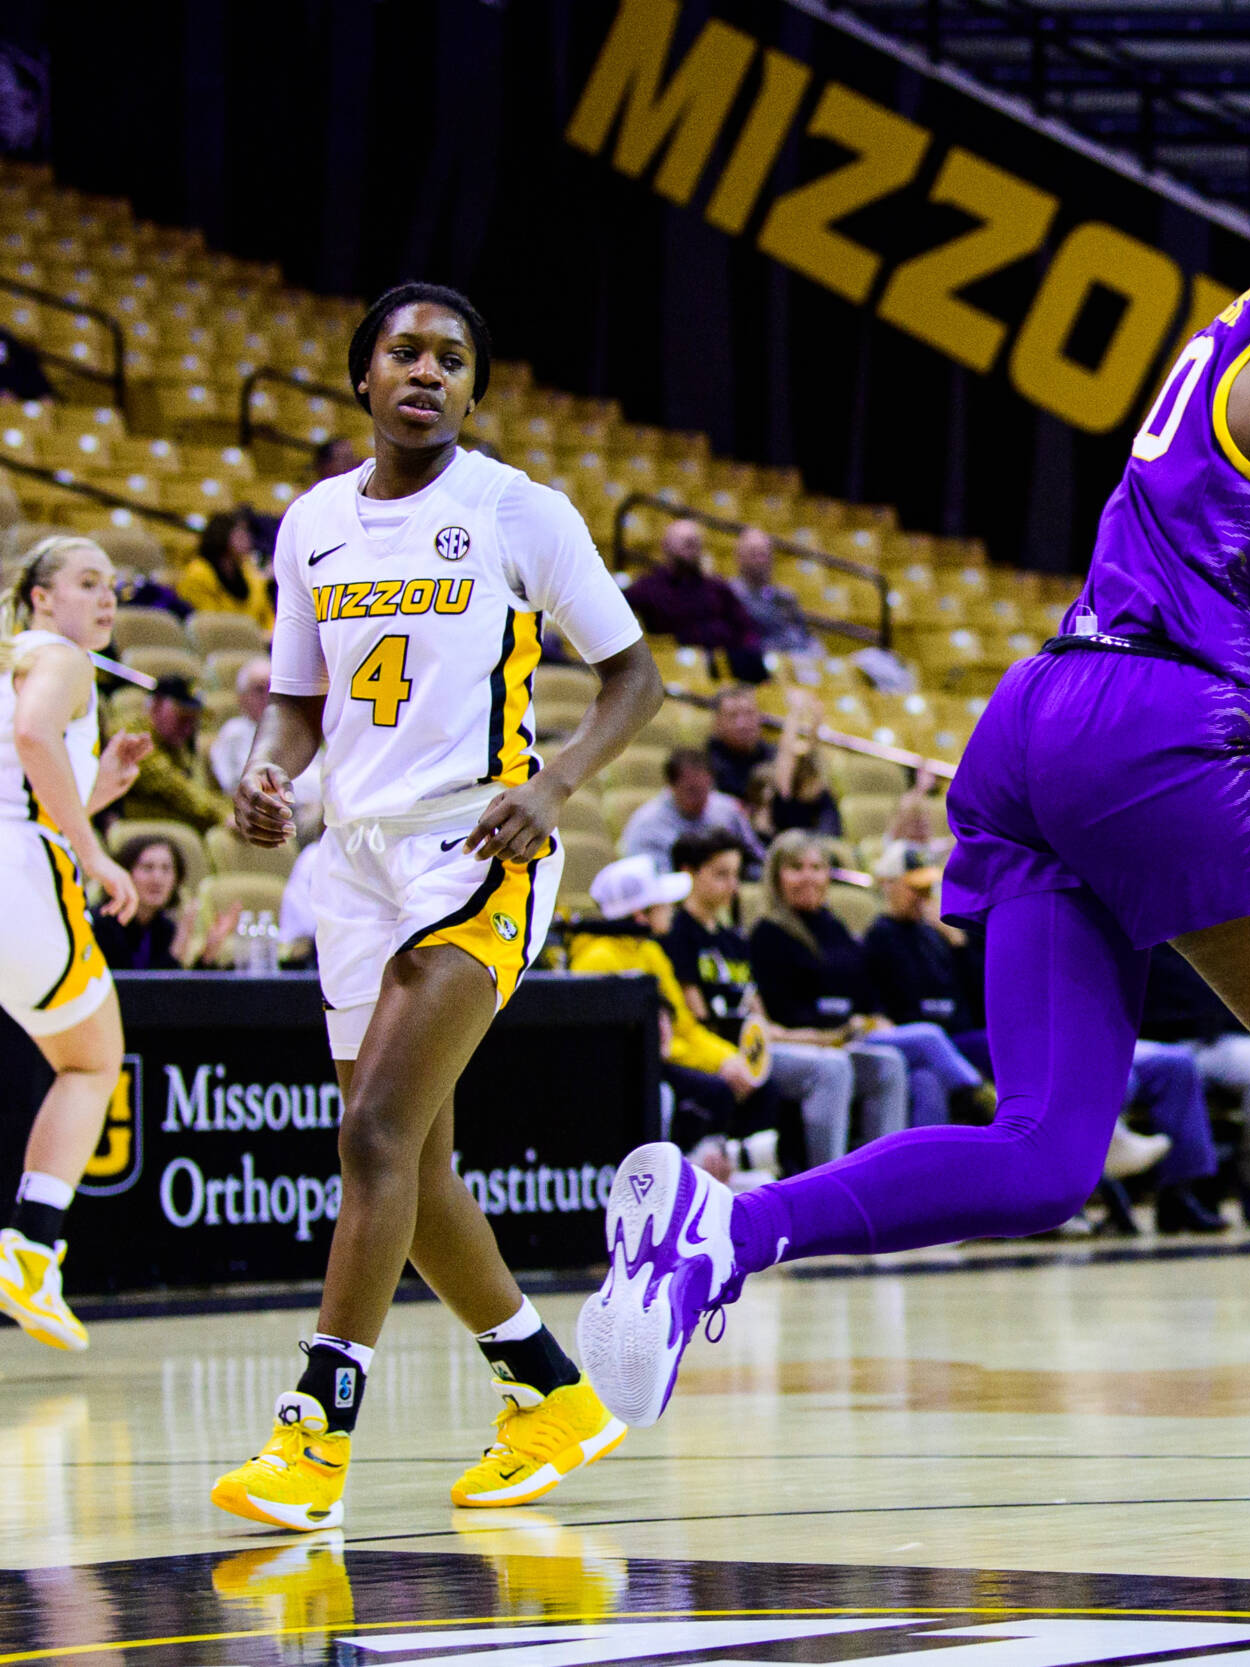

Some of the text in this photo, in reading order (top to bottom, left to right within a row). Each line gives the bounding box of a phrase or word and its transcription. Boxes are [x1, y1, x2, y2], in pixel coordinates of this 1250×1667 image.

[564, 0, 1238, 433] MIZZO
[434, 526, 471, 561] SEC
[350, 634, 412, 728] 4
[163, 1064, 345, 1132] Missour
[161, 1148, 617, 1240] Orthopa nstitute
